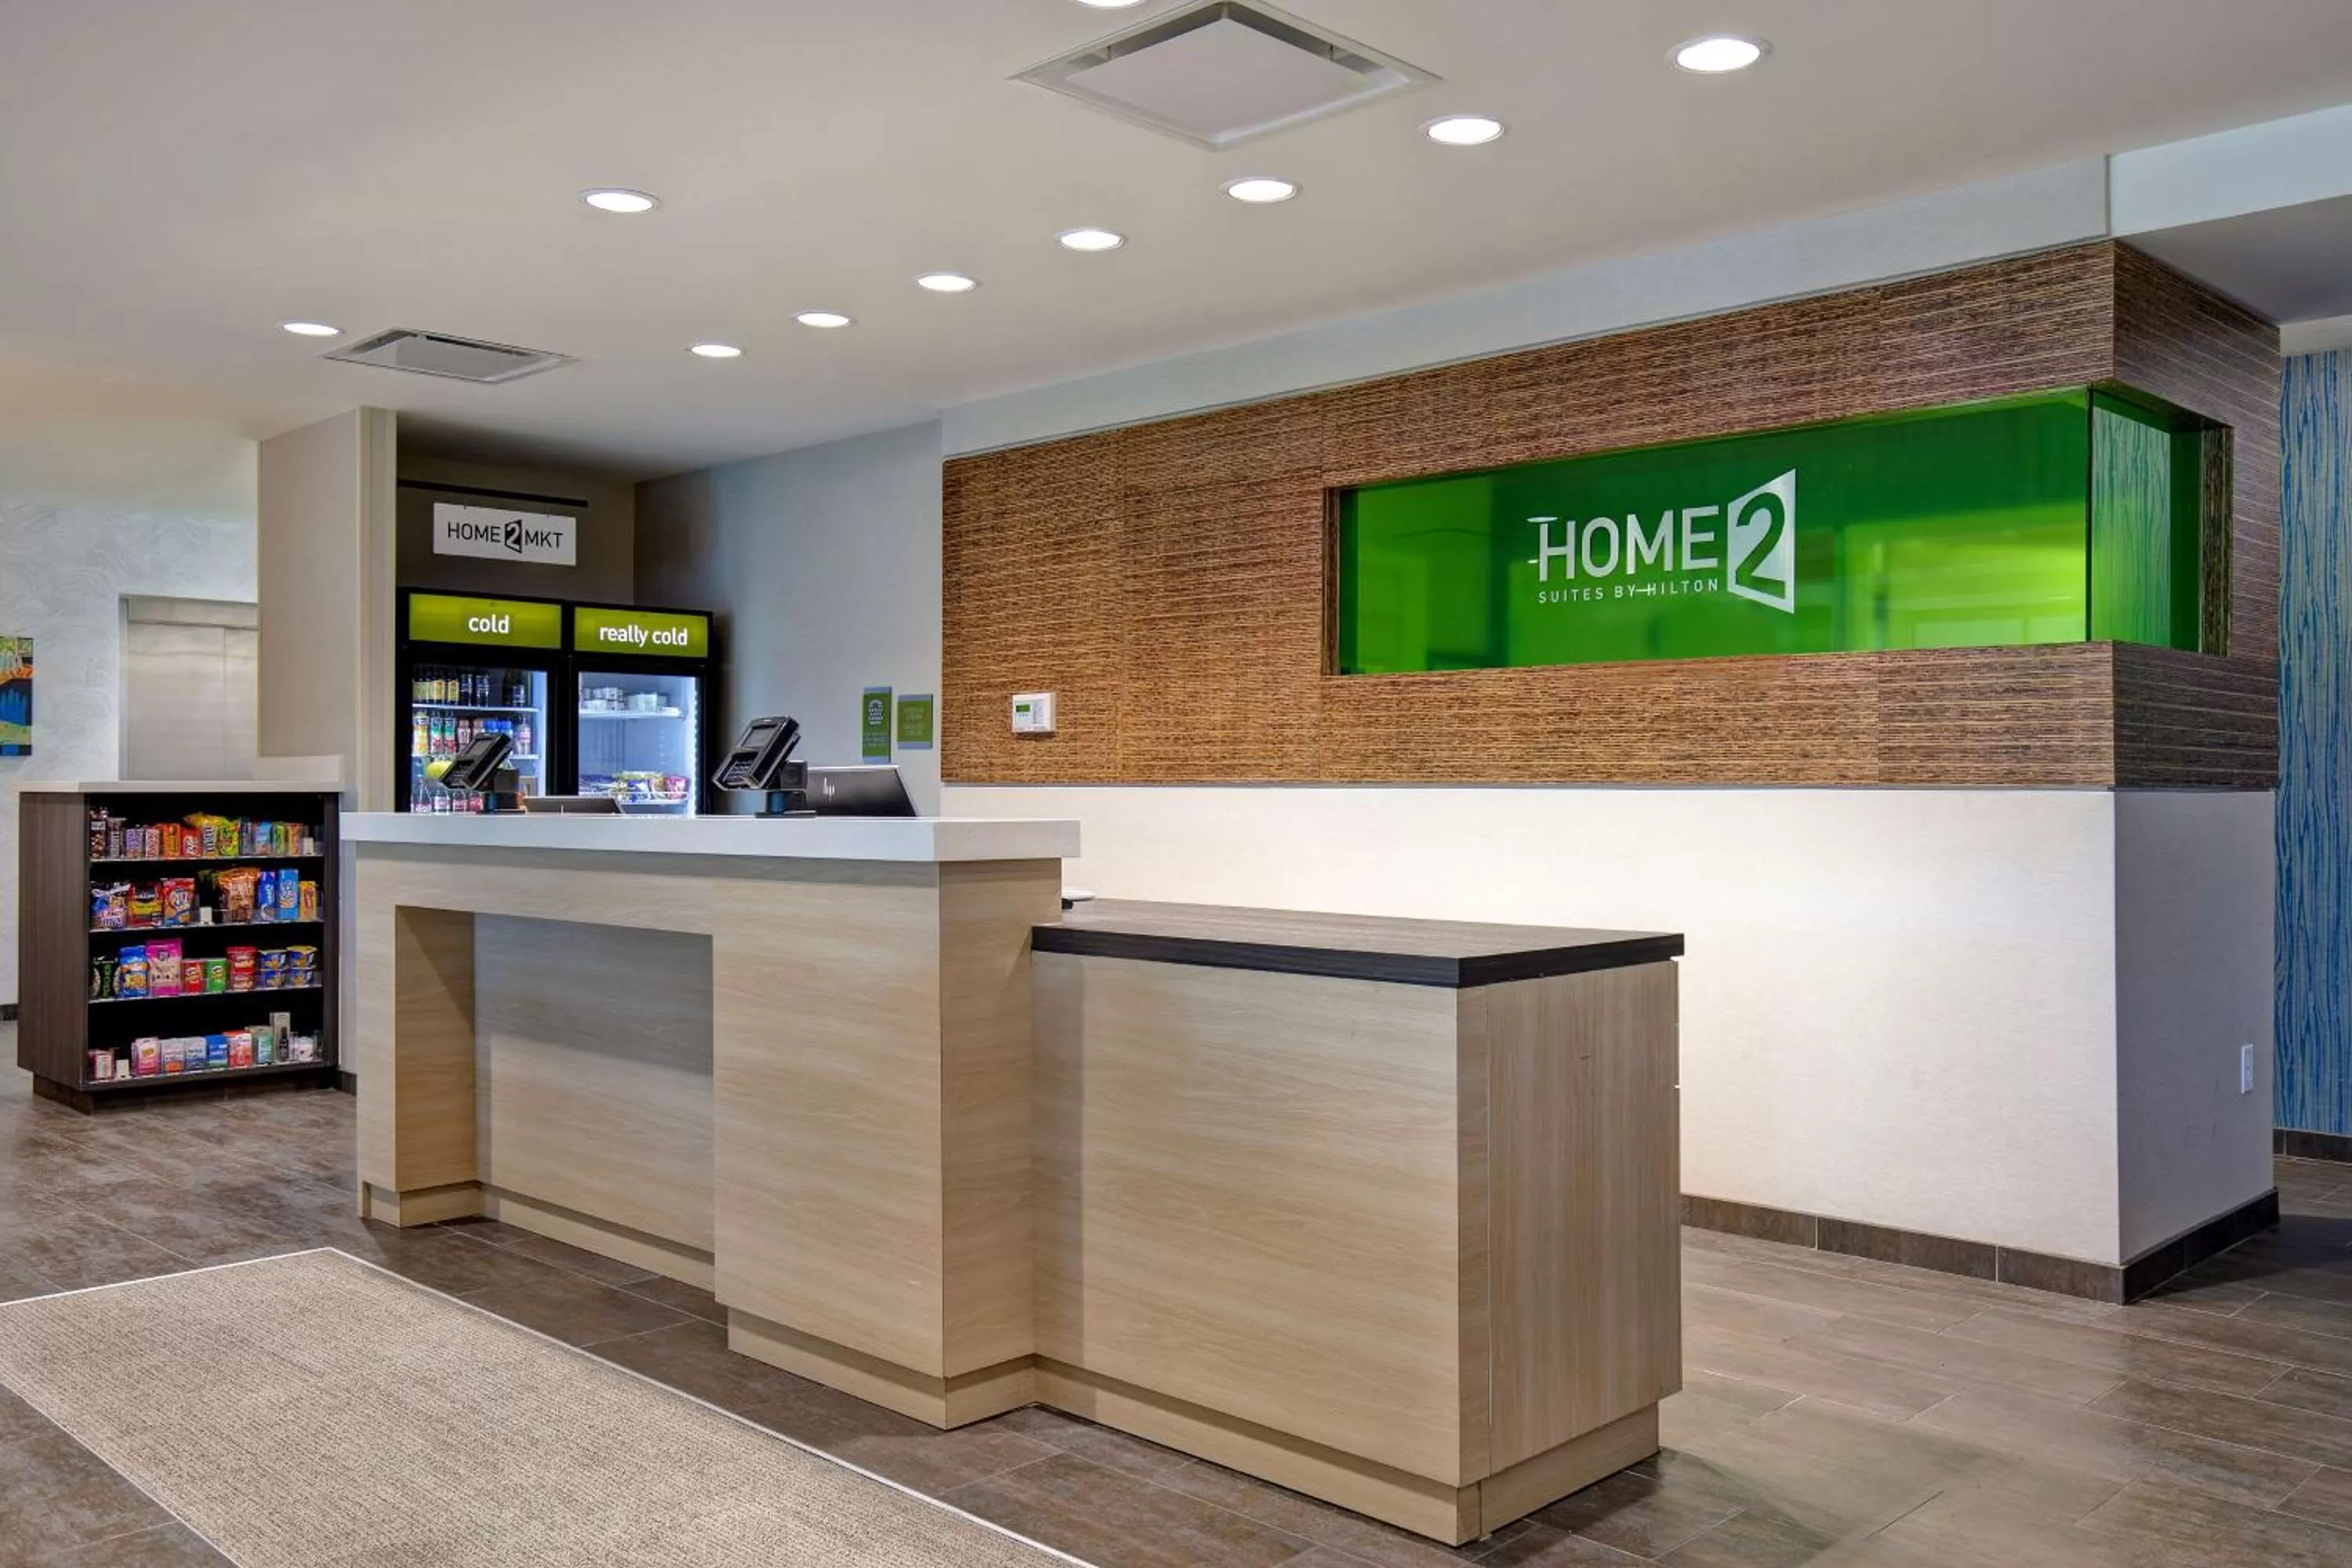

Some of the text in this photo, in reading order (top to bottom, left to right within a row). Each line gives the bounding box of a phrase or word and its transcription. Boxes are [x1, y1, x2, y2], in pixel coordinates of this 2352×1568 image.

[1538, 578, 1719, 604] SUITES BY HILTON
[468, 614, 510, 635] cold
[599, 624, 688, 647] really cold
